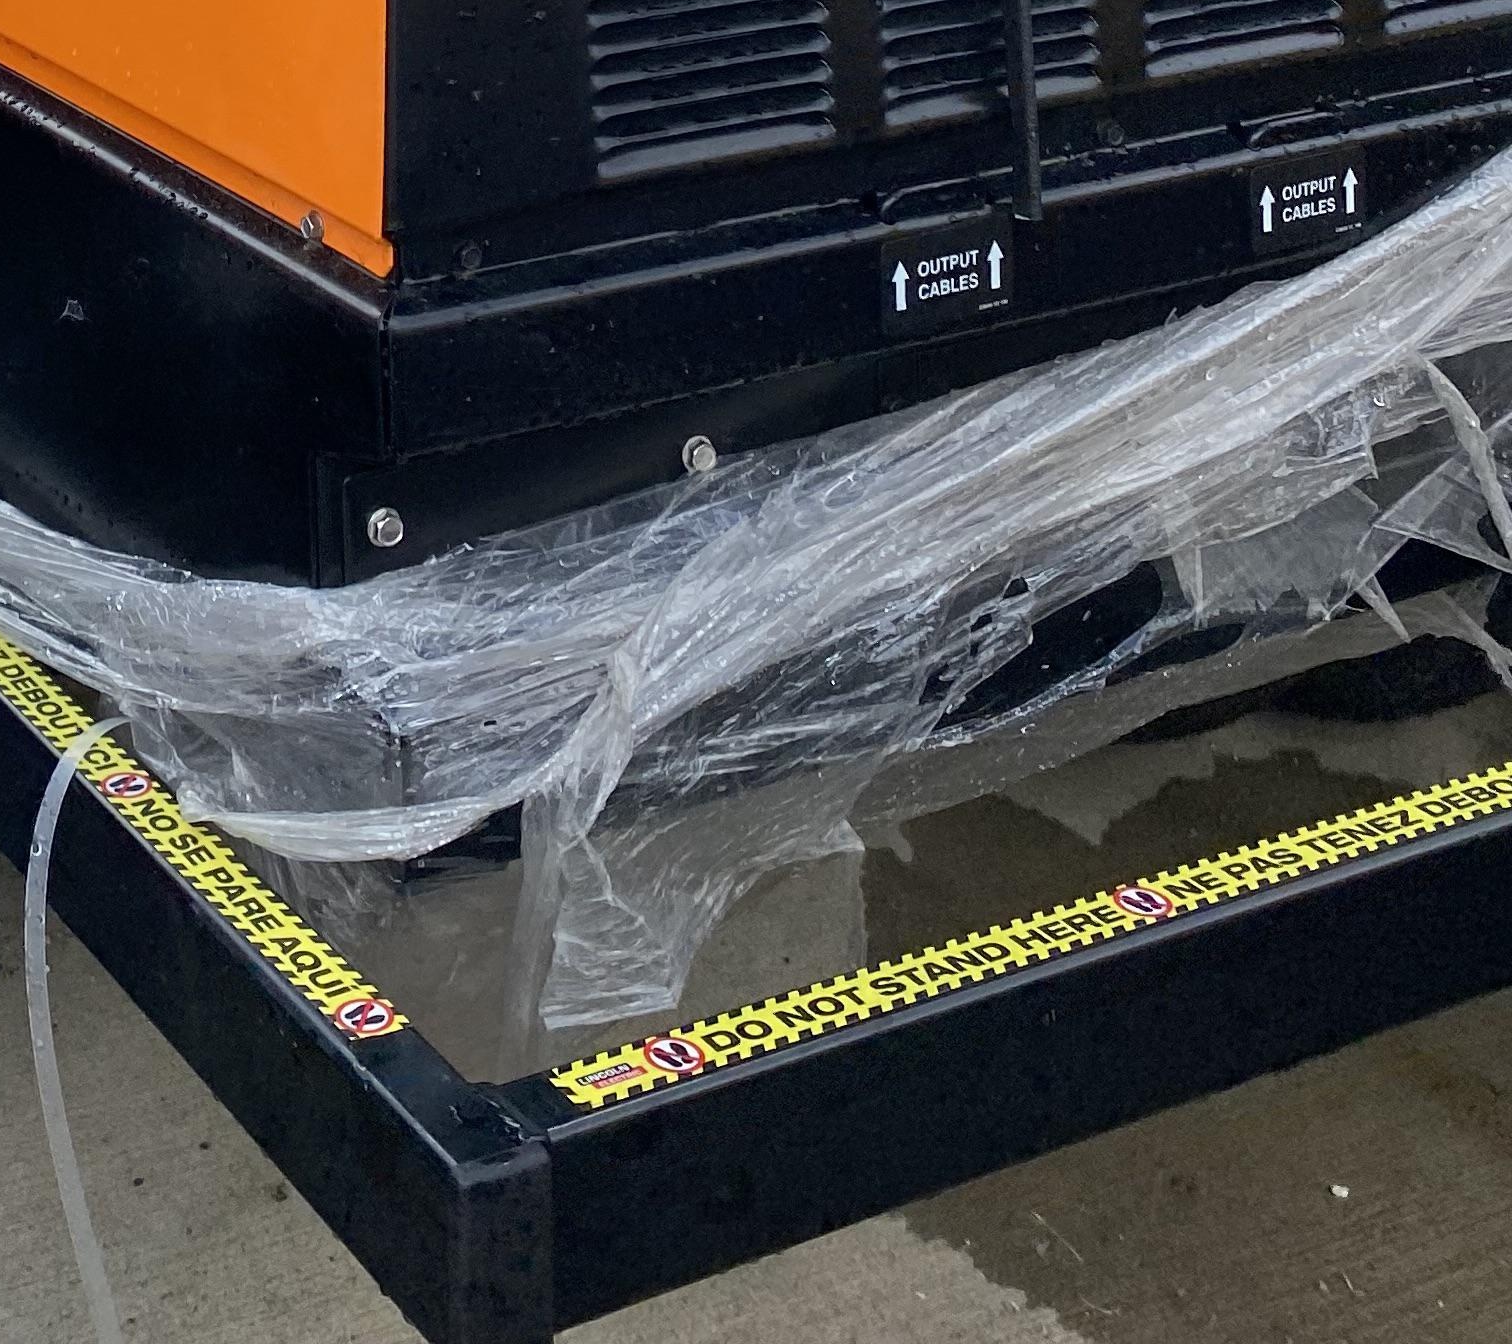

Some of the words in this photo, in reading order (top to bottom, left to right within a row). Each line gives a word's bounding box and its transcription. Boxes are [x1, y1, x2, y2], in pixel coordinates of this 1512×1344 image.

[1281, 175, 1337, 201] OUTPUT
[1282, 197, 1336, 223] CABLES
[917, 249, 980, 278] OUTPUT
[918, 272, 980, 300] CABLES
[131, 799, 179, 833] NO
[169, 833, 216, 867] SE
[203, 866, 285, 933] PARE
[1162, 871, 1229, 900] NE
[1220, 847, 1304, 881] PAS
[1295, 808, 1424, 854] TENEZ
[701, 1019, 774, 1053] DO
[772, 985, 874, 1026] NOT
[868, 941, 1011, 998] STAND
[1007, 904, 1130, 951] HERE
[577, 1064, 631, 1085] LINCOLN
